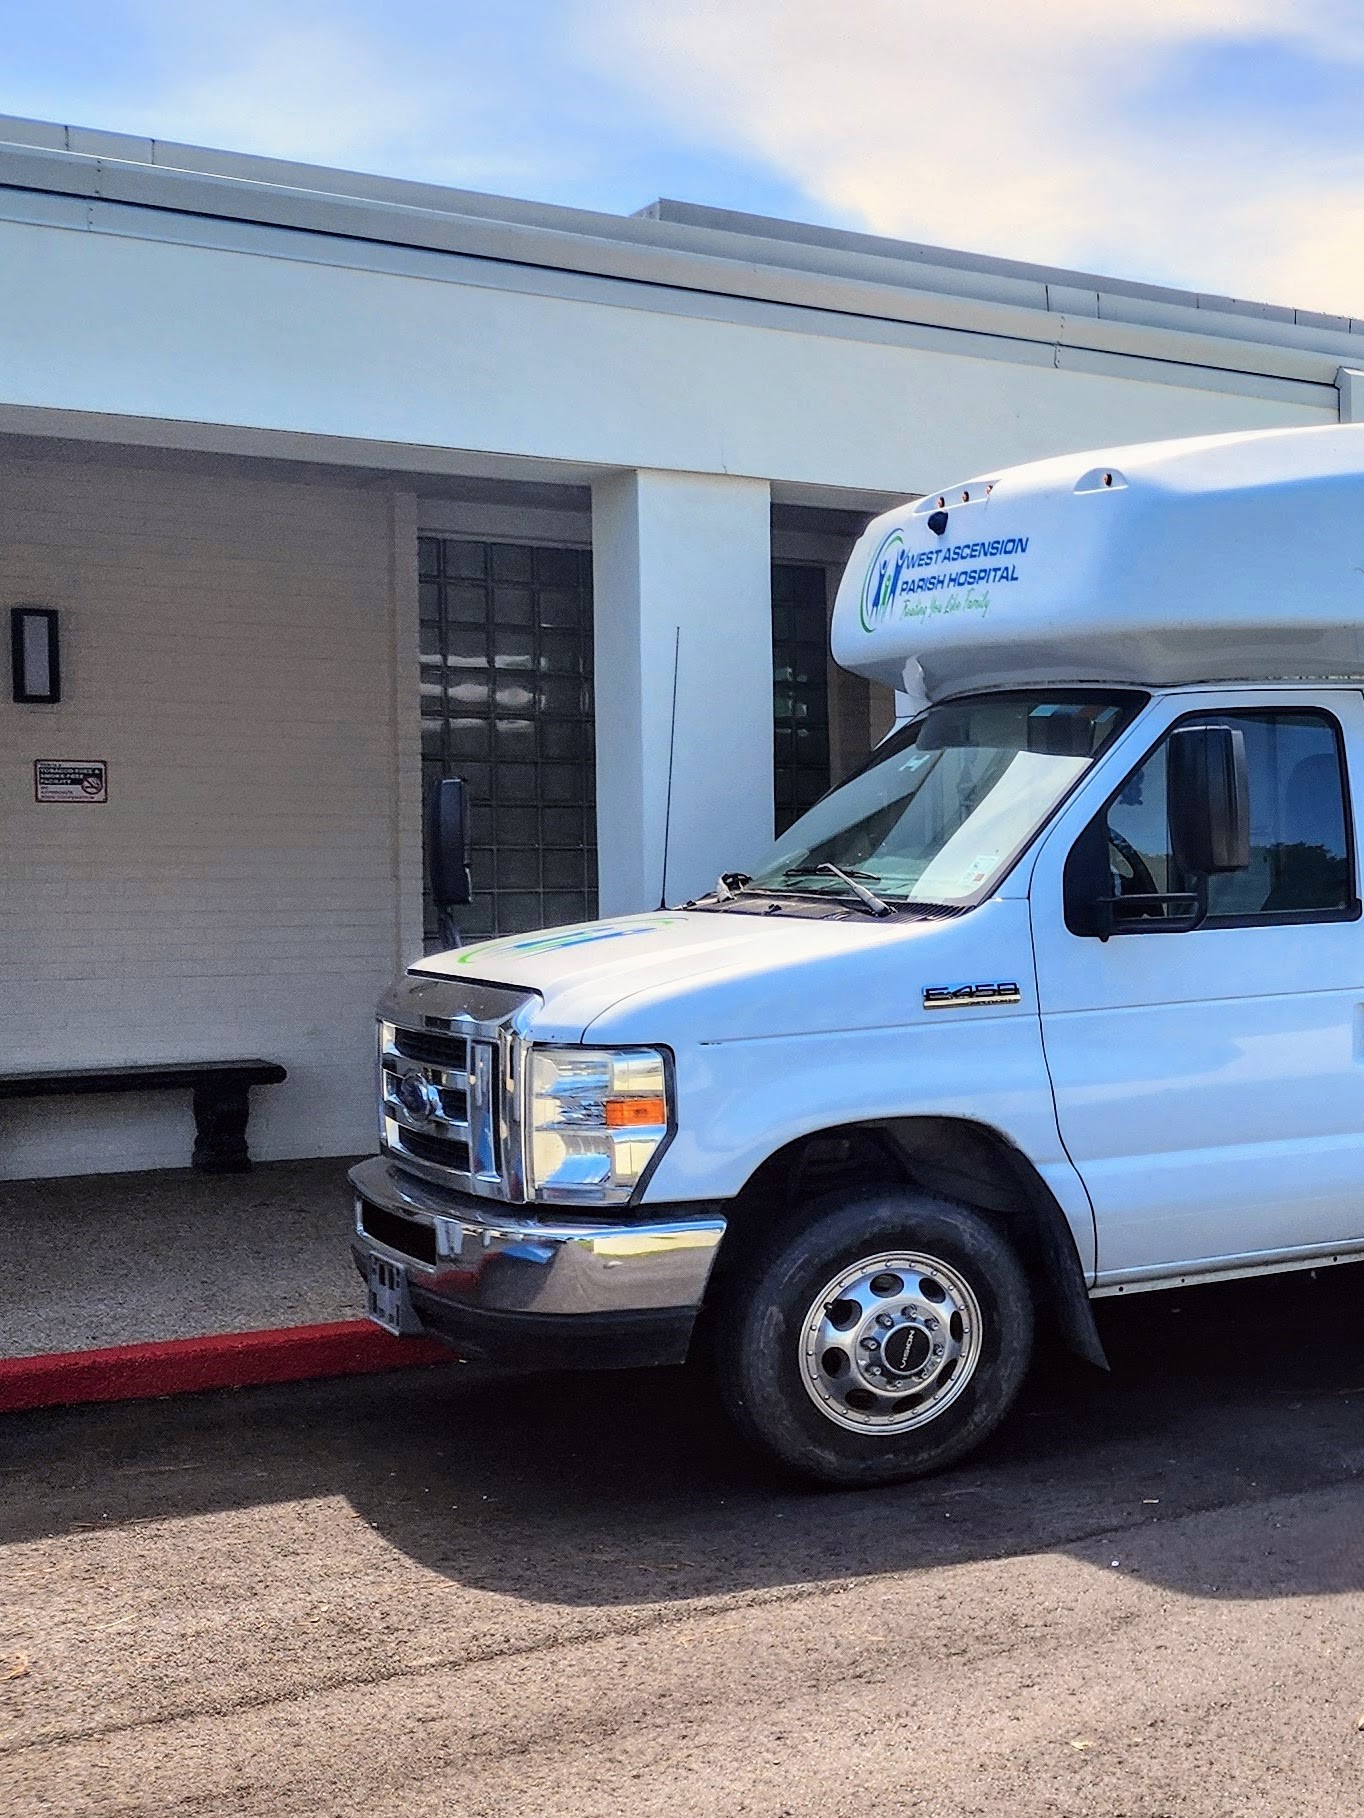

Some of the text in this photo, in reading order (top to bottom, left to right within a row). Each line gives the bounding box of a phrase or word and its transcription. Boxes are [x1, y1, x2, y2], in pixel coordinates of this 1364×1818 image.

[906, 537, 1029, 570] WEST ASCENSION
[900, 564, 1019, 596] PARISH HOSPITAL
[900, 1330, 915, 1369] VISION
